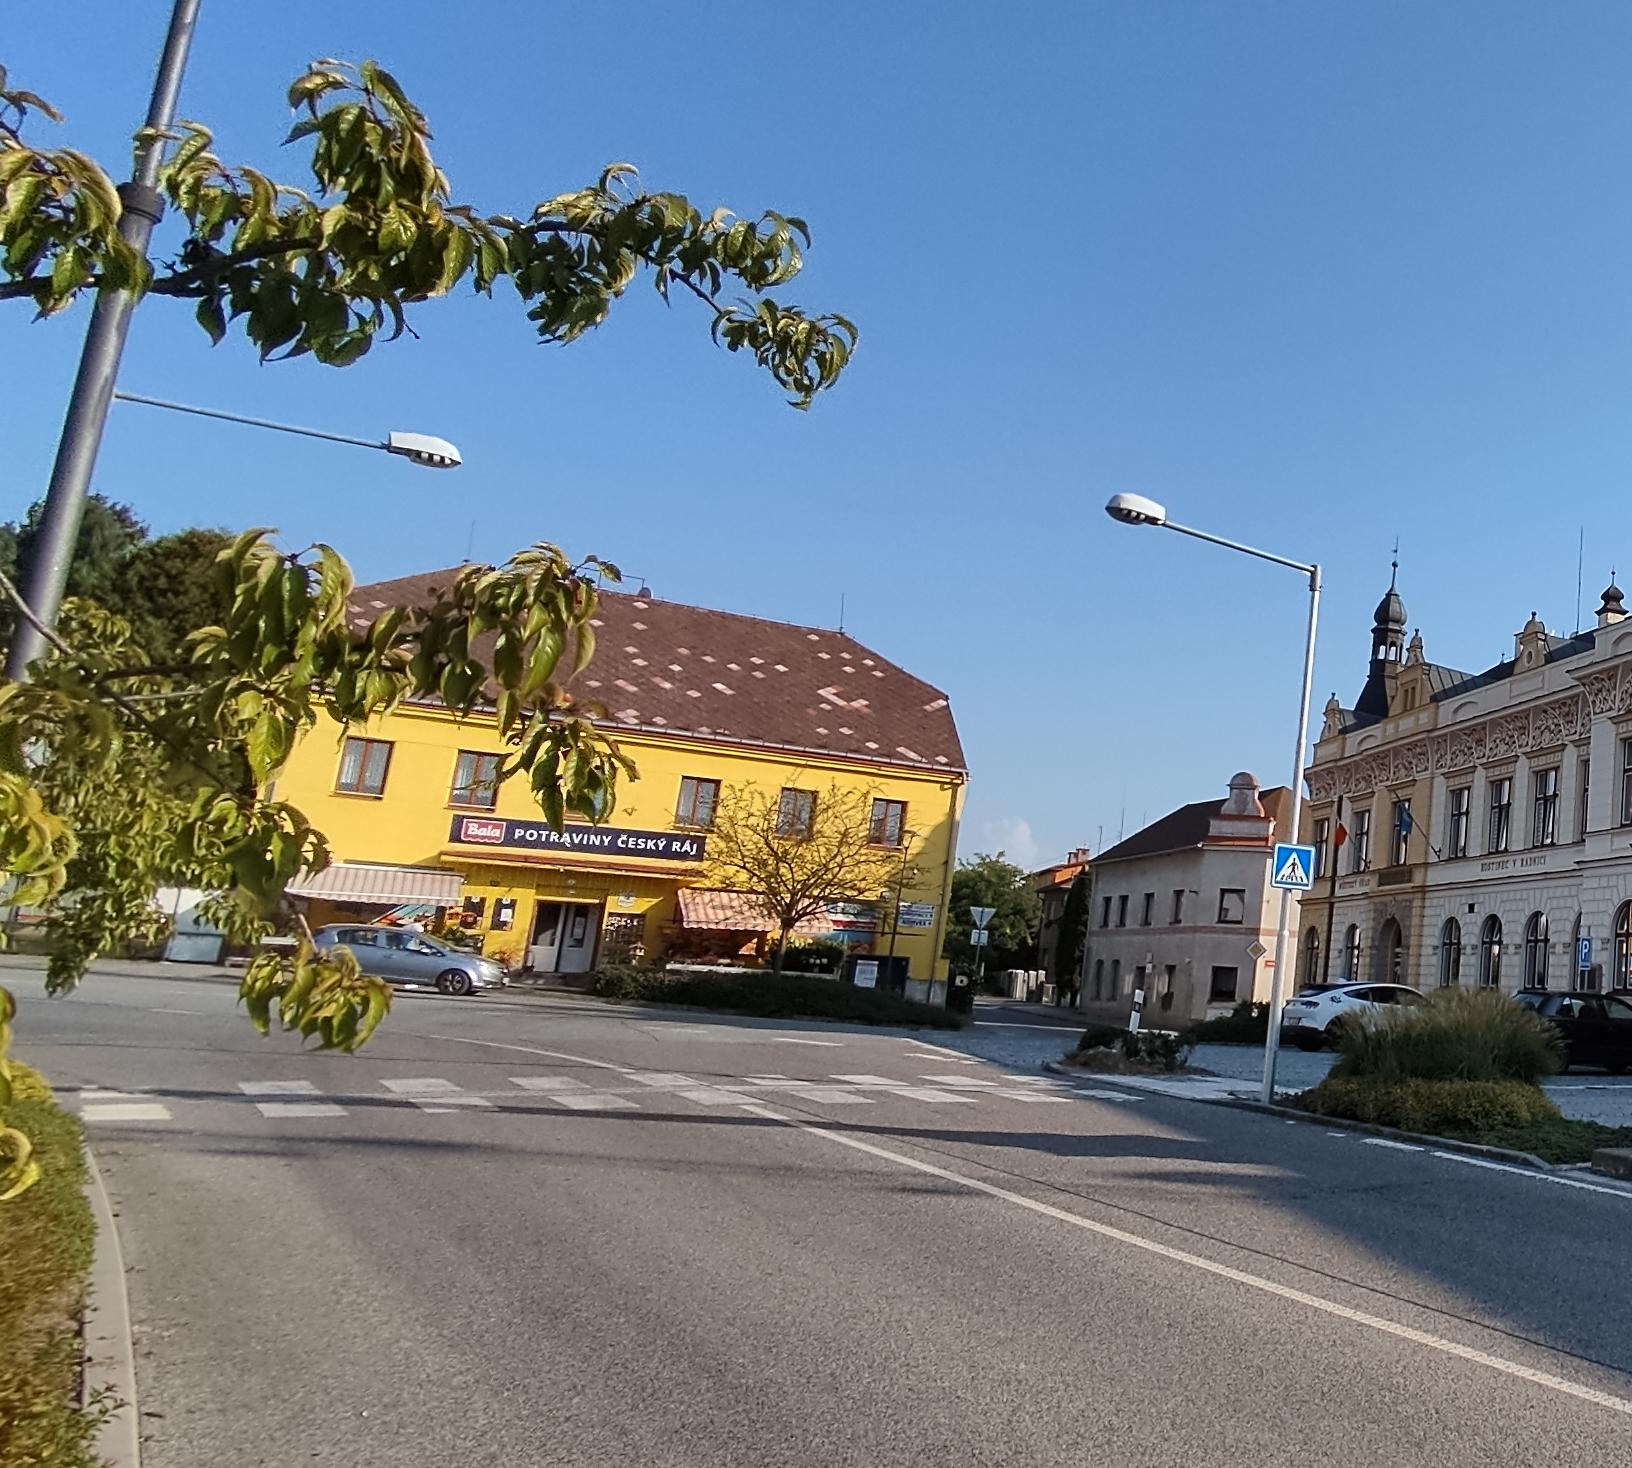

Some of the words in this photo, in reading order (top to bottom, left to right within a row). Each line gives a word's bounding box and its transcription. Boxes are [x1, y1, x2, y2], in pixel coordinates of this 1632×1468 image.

[467, 823, 501, 837] Bala
[514, 828, 612, 847] POTRAVINY
[617, 834, 667, 851] ČESKÝ
[672, 839, 697, 856] RÁJ
[1582, 940, 1589, 959] P
